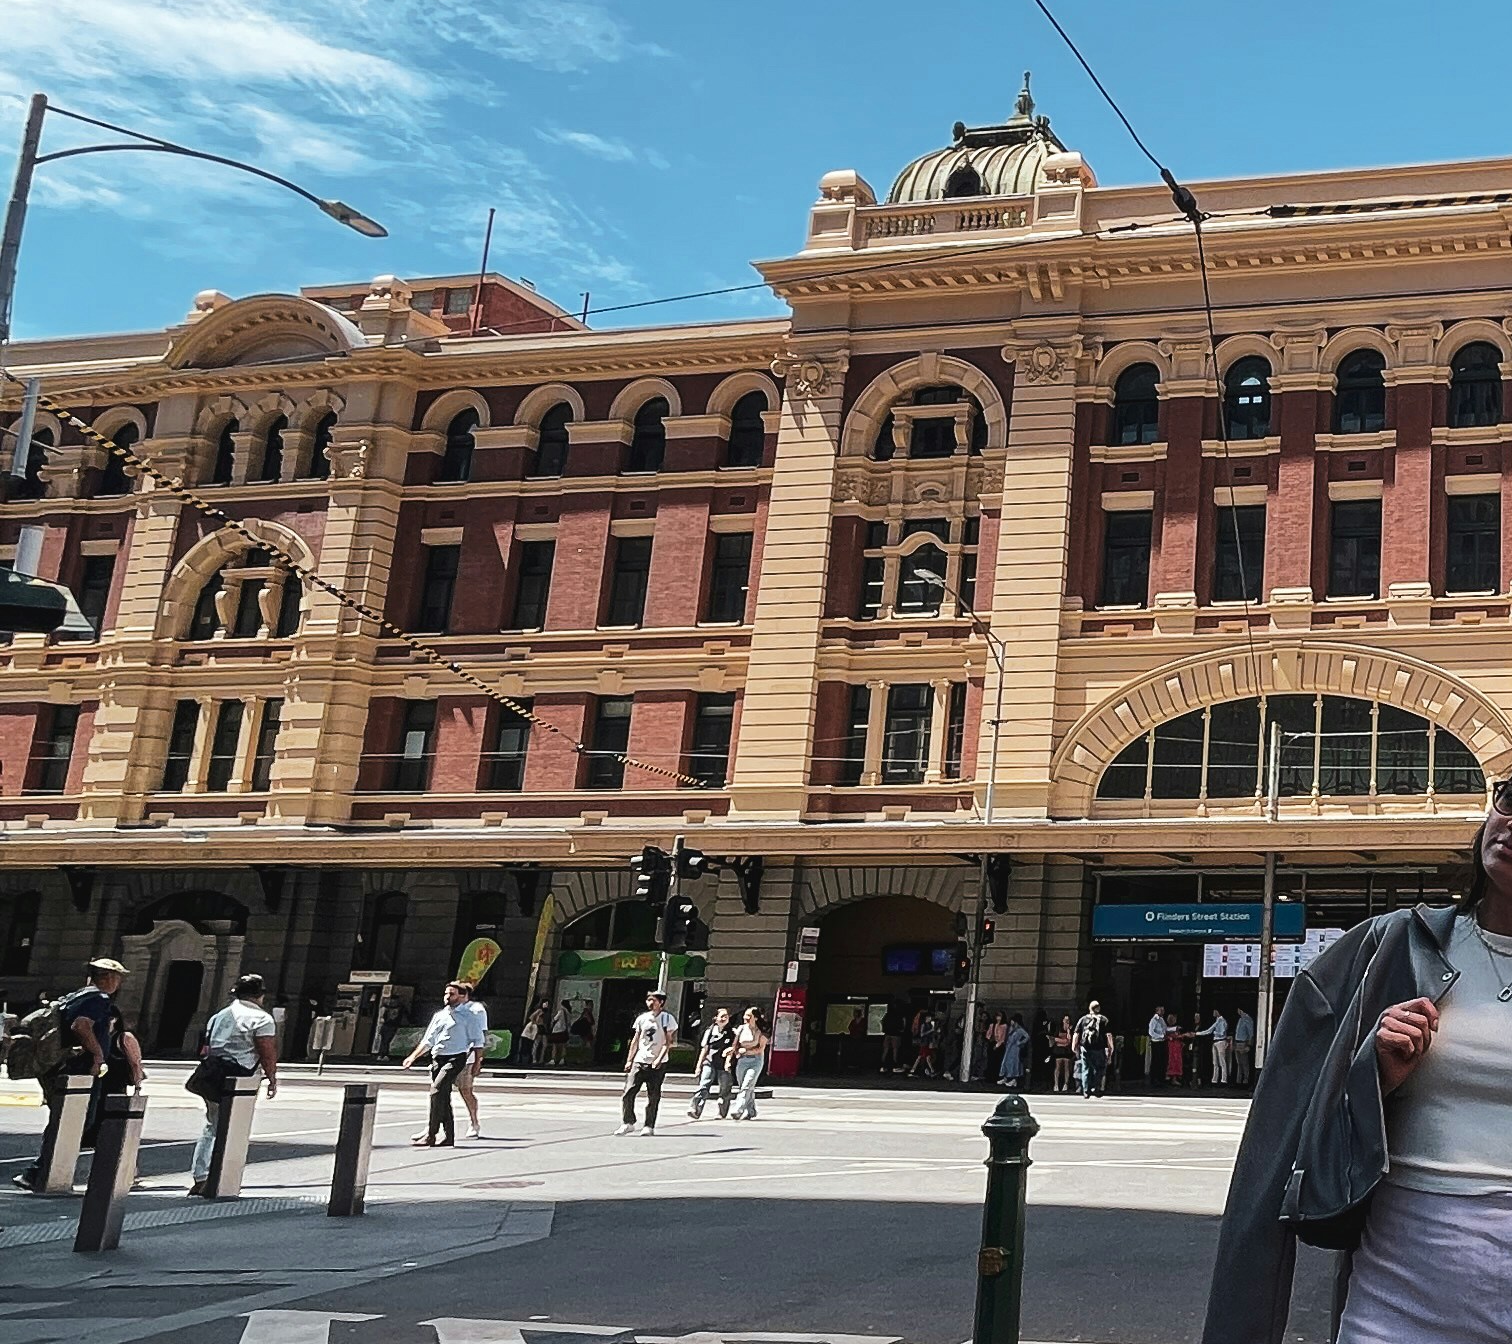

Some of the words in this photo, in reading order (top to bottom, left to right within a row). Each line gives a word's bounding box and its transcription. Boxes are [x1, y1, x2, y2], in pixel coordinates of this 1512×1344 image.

[1156, 912, 1190, 921] Flinders
[1191, 912, 1218, 921] Street
[1220, 912, 1251, 921] Station
